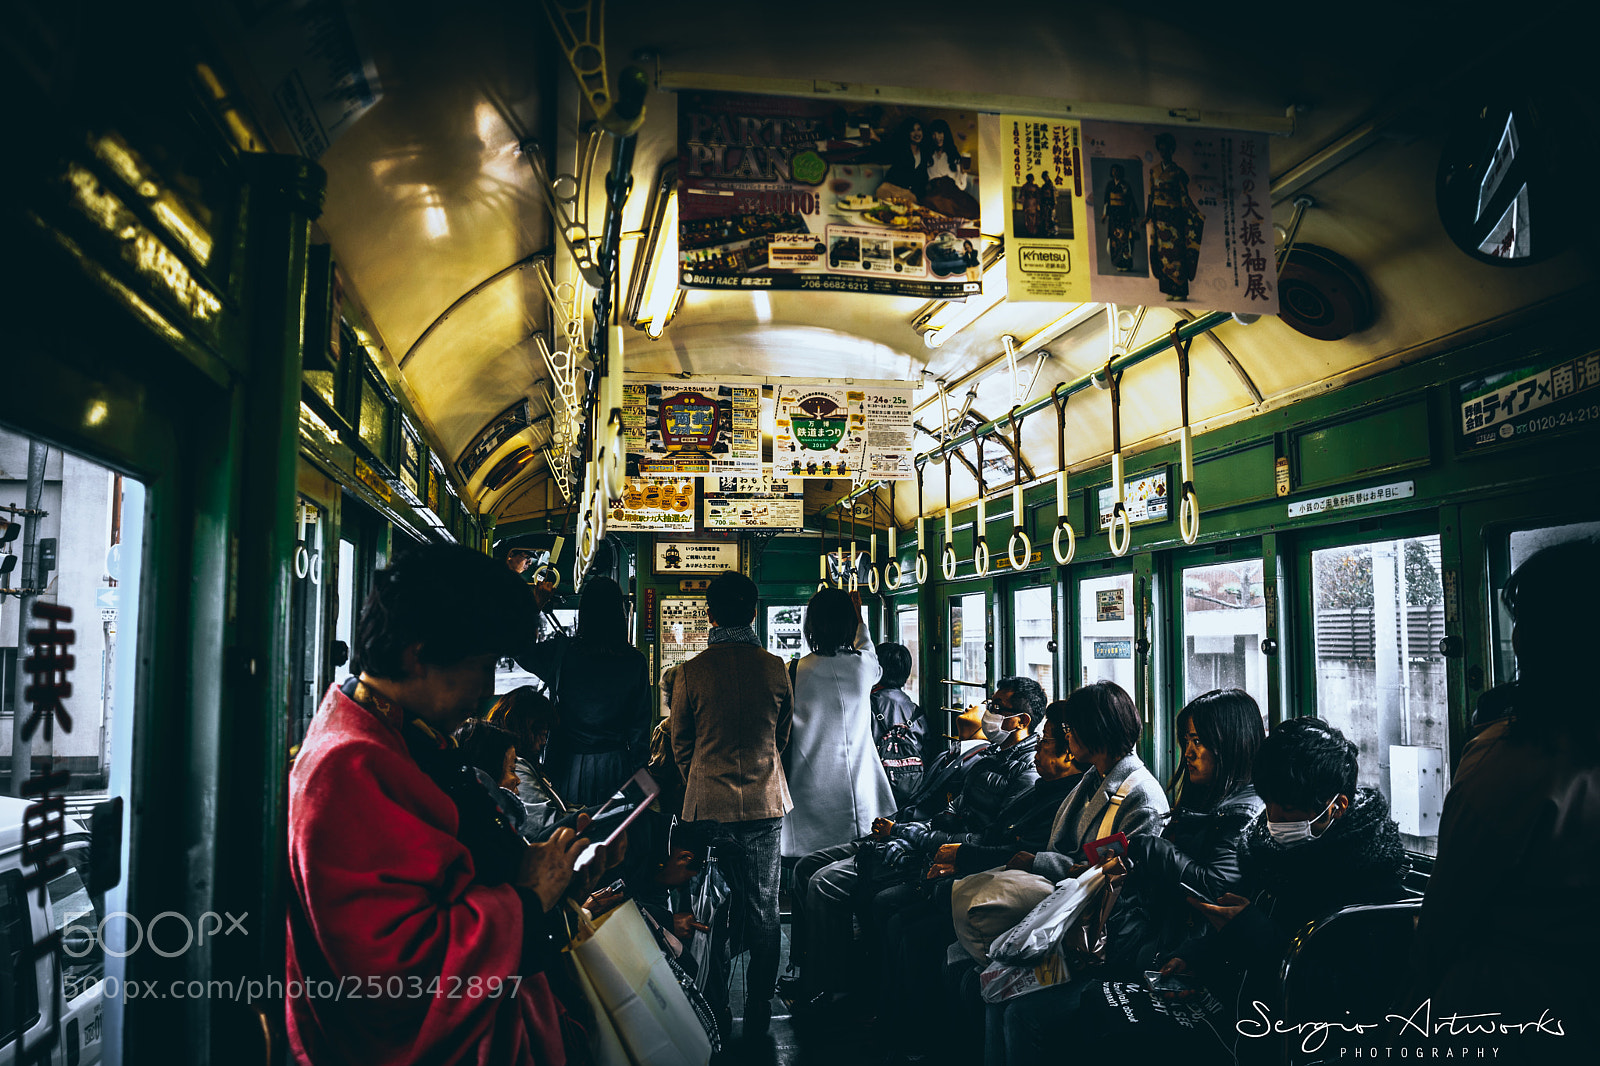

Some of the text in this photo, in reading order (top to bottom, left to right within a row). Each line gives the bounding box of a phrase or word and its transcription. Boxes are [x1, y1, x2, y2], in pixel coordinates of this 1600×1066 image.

[686, 142, 795, 181] PLAN
[1239, 139, 1270, 301] 近鉄の大振袖展
[693, 275, 714, 284] BOAT
[716, 276, 738, 285] RACE
[809, 280, 869, 291] 06-6682-6212
[1529, 405, 1600, 432] 0120-24-213
[797, 427, 842, 437] 鉄道まつり
